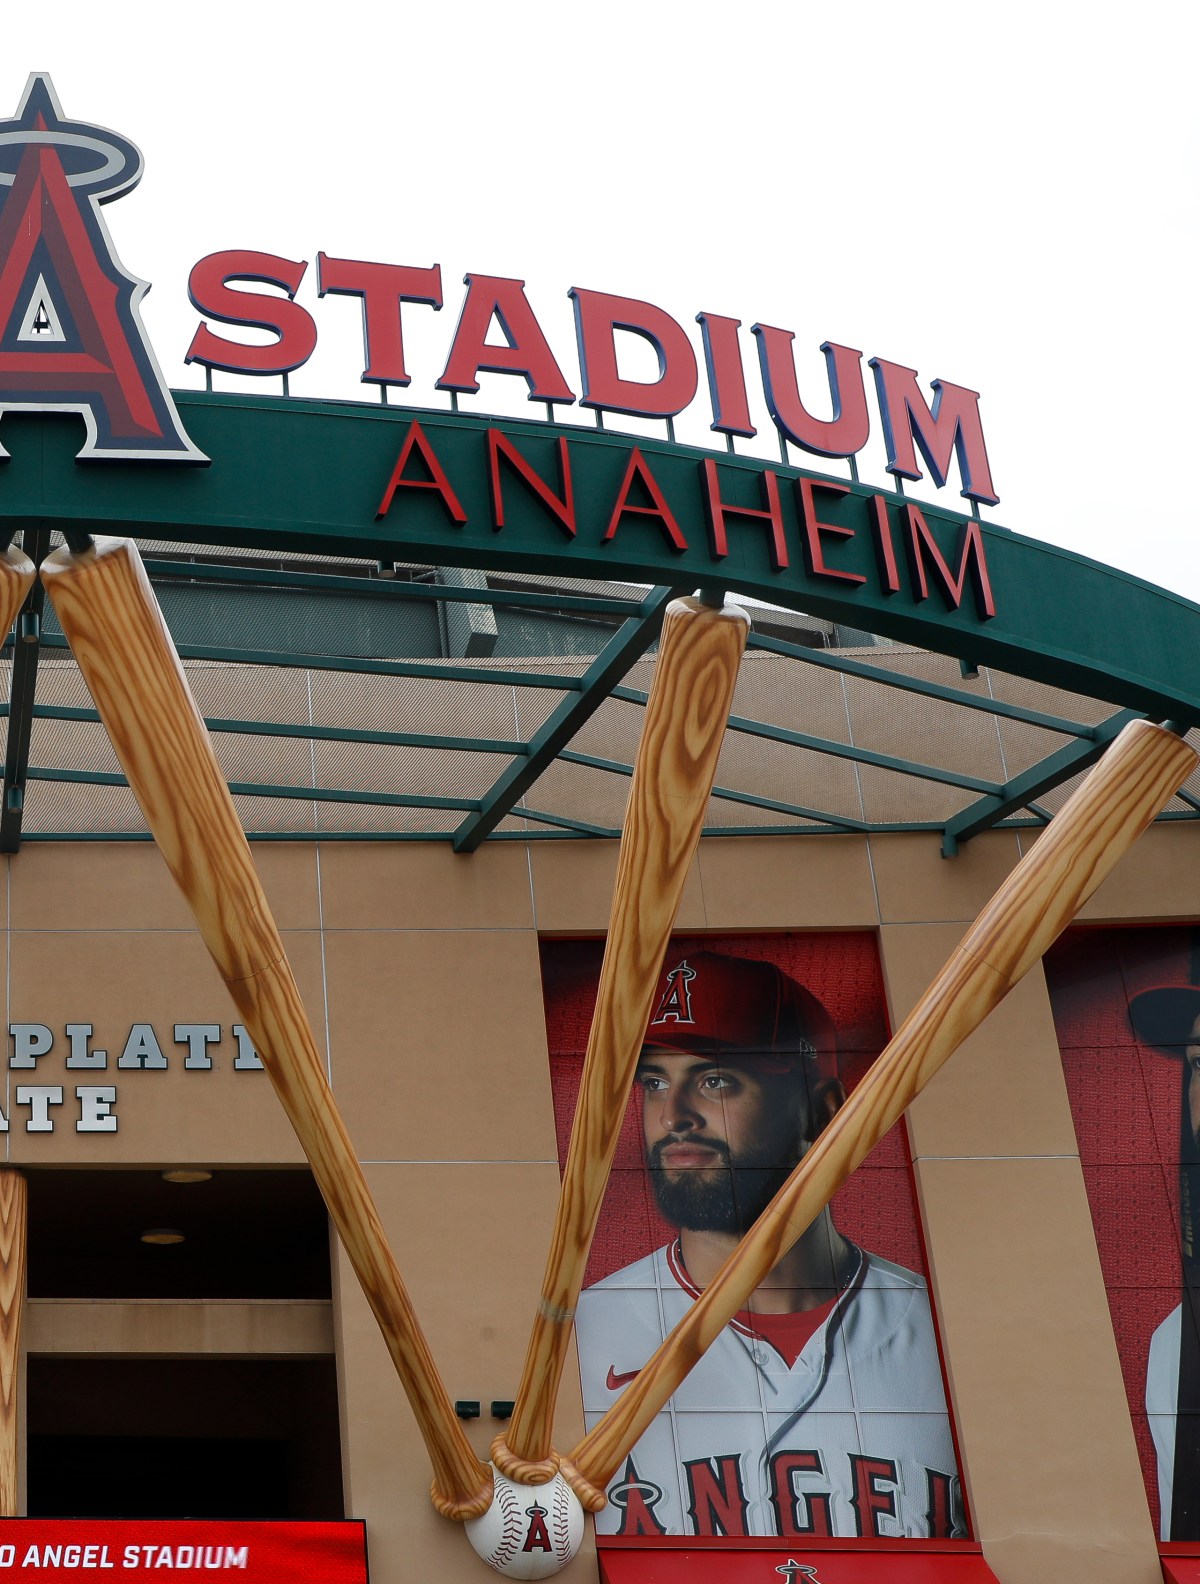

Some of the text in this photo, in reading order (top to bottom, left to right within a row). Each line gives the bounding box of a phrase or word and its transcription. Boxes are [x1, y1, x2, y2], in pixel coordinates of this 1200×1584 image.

[184, 249, 1000, 507] STADIUM
[375, 419, 996, 620] ANAHEIM
[22, 1545, 114, 1568] ANGEL
[122, 1545, 249, 1569] STADIUM
